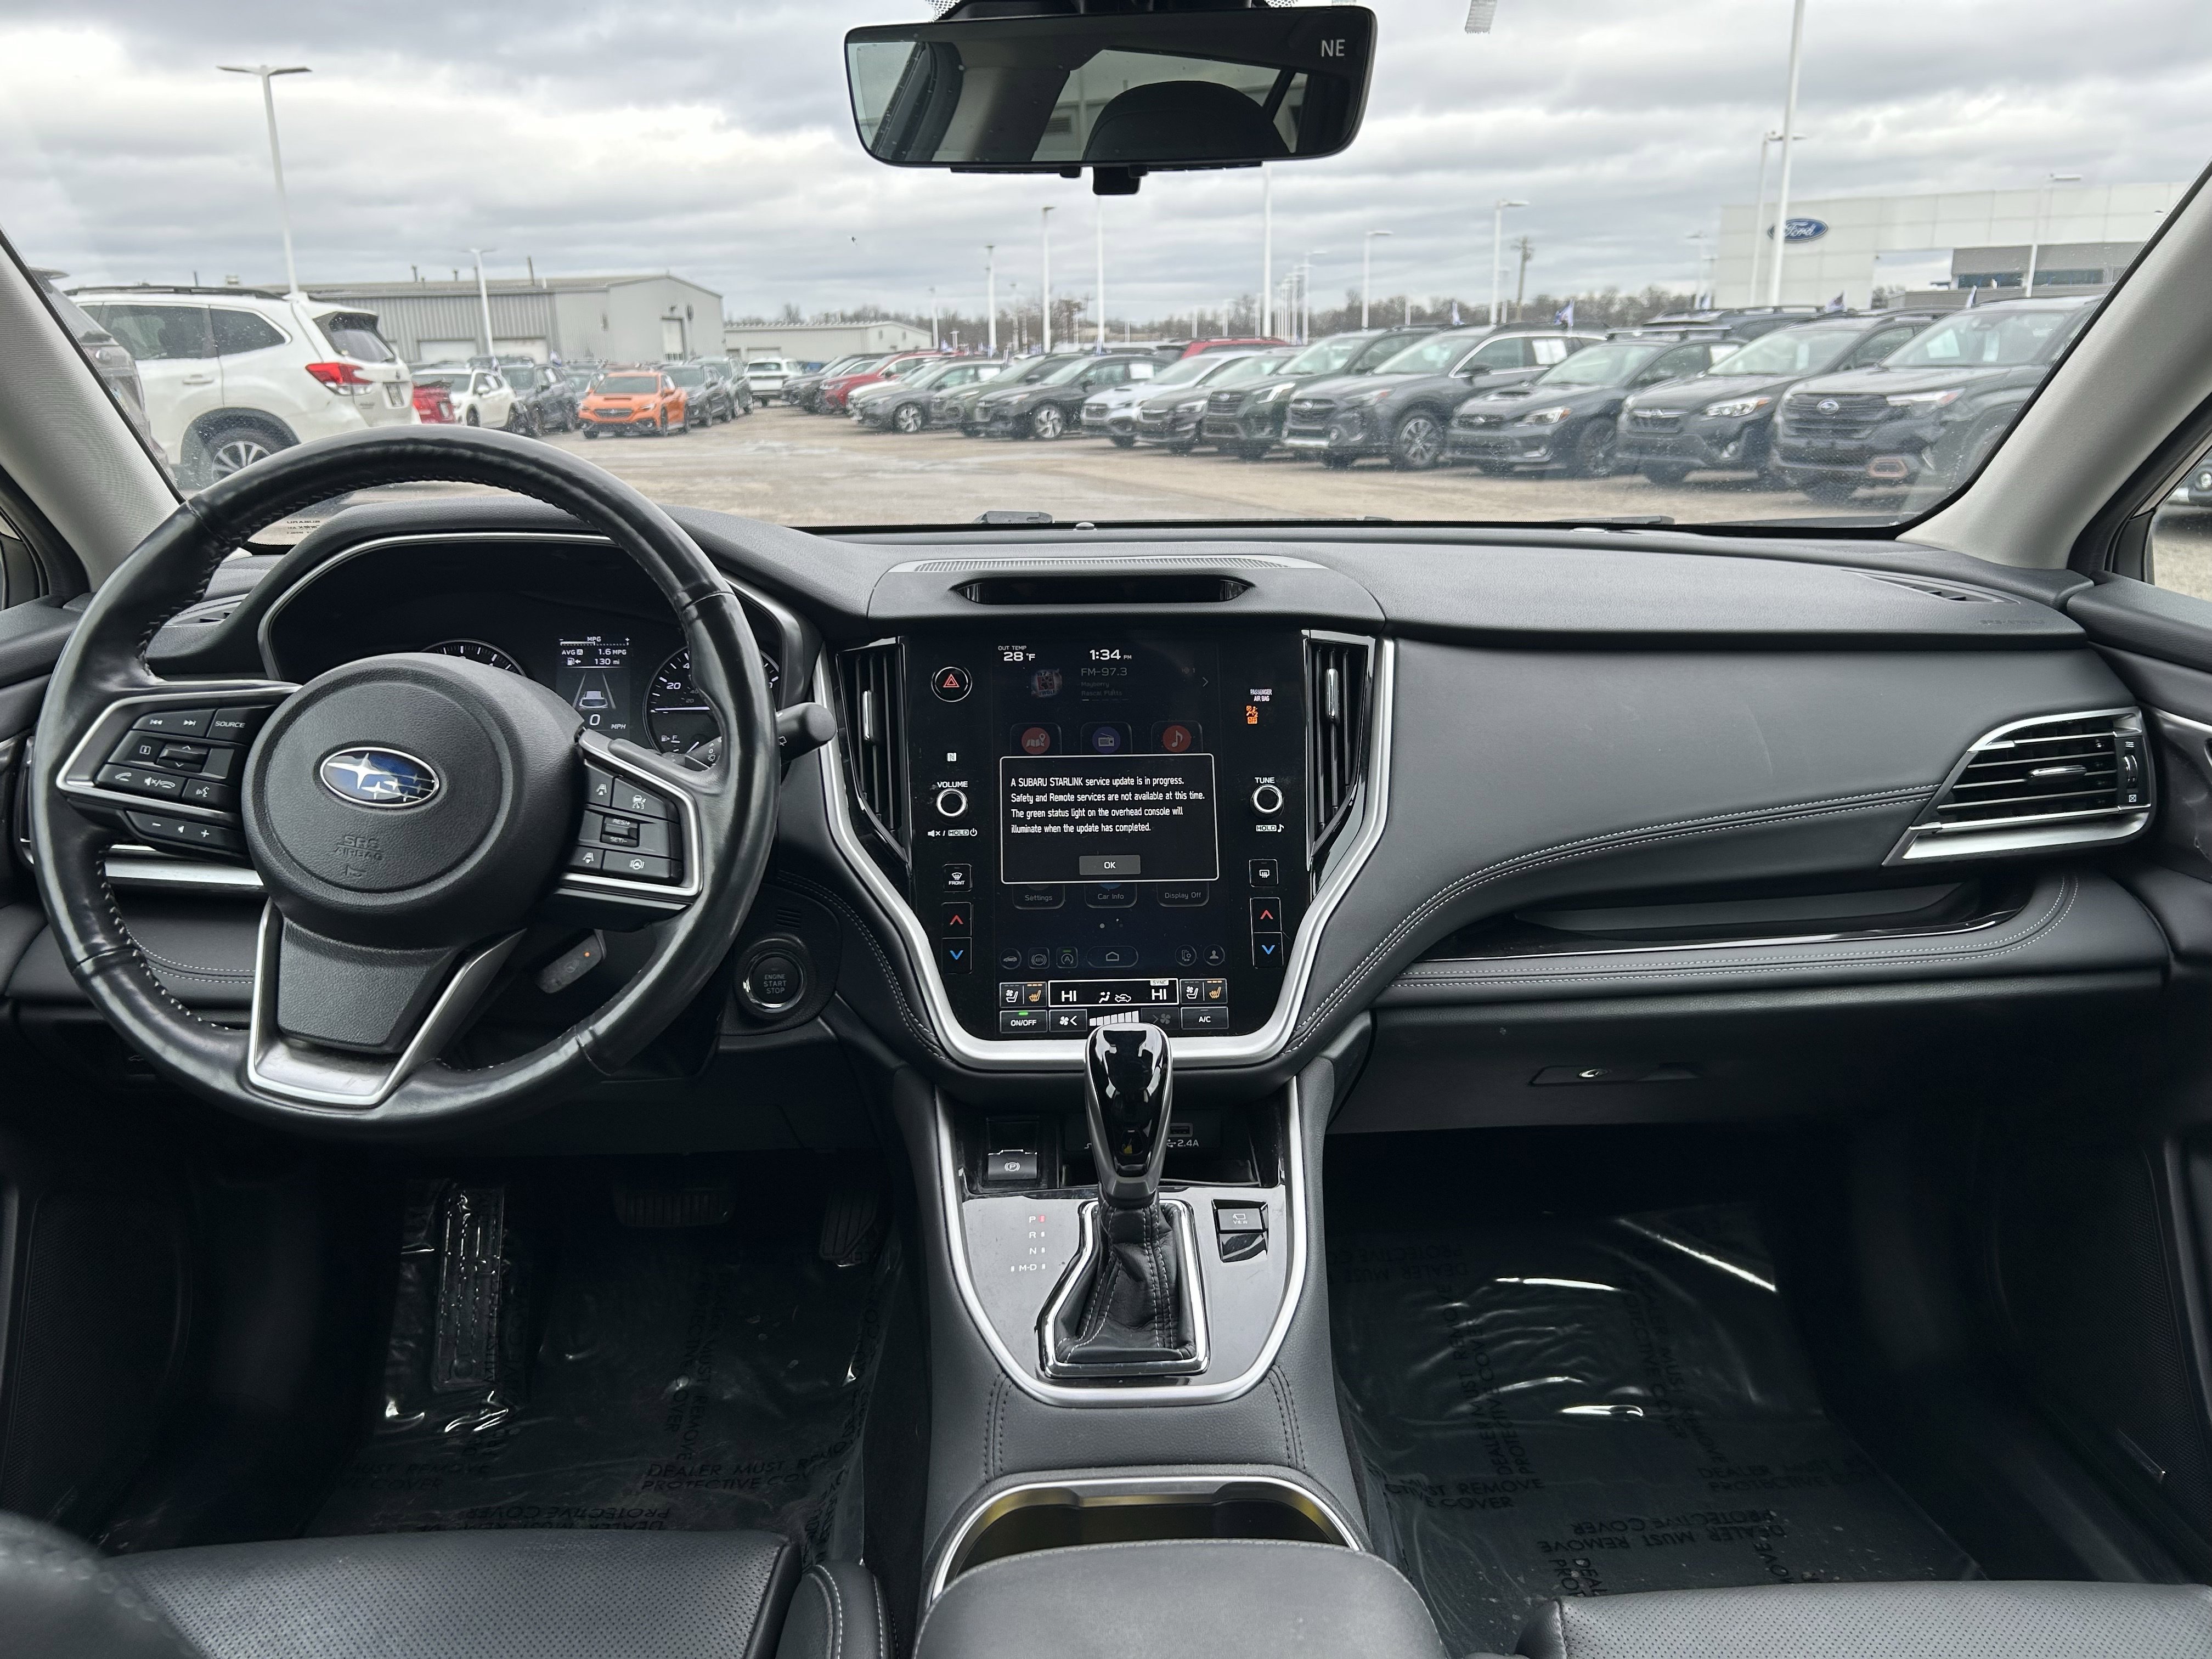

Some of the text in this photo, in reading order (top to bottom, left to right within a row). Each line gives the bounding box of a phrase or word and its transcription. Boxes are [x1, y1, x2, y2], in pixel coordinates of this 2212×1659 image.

[1321, 40, 1345, 57] NE
[1785, 221, 1817, 237] Ford
[1003, 651, 1023, 662] 28
[1090, 649, 1121, 660] 1:34
[1081, 667, 1127, 676] FM-97.3
[590, 714, 601, 726] 0
[1011, 776, 1184, 787] A SUBARU STARLINK service update is in progress.
[1011, 793, 1034, 804] Safety
[1035, 793, 1047, 802] and
[1049, 793, 1075, 802] Remote
[1077, 792, 1105, 802] services
[1121, 792, 1132, 800] not
[1134, 791, 1163, 800] available
[1165, 791, 1172, 800] at
[1175, 791, 1187, 800] this
[1189, 791, 1205, 799] time.
[1011, 809, 1024, 818] The
[1026, 810, 1046, 820] green
[1048, 808, 1069, 817] status
[1071, 808, 1086, 819] light
[1098, 808, 1109, 816] the
[1111, 807, 1142, 816] overhead
[1144, 806, 1170, 816] console
[1172, 806, 1183, 815] will
[1011, 822, 1152, 834] illuminate when the update has completed.
[1062, 990, 1076, 1002] HI
[1152, 989, 1167, 1000] HI
[676, 1393, 709, 1462] REMOVE
[646, 1463, 723, 1477] DEALER
[733, 1460, 786, 1475] MUST
[641, 1477, 761, 1490] PROTECTIVE
[1455, 1479, 1547, 1495] REMOVE
[1438, 1496, 1515, 1510] COVER
[546, 1506, 672, 1520] PROTECTIVE
[1571, 1517, 1646, 1536] COVER
[1537, 1534, 1631, 1553] REMOVE
[1644, 1530, 1696, 1548] MUST
